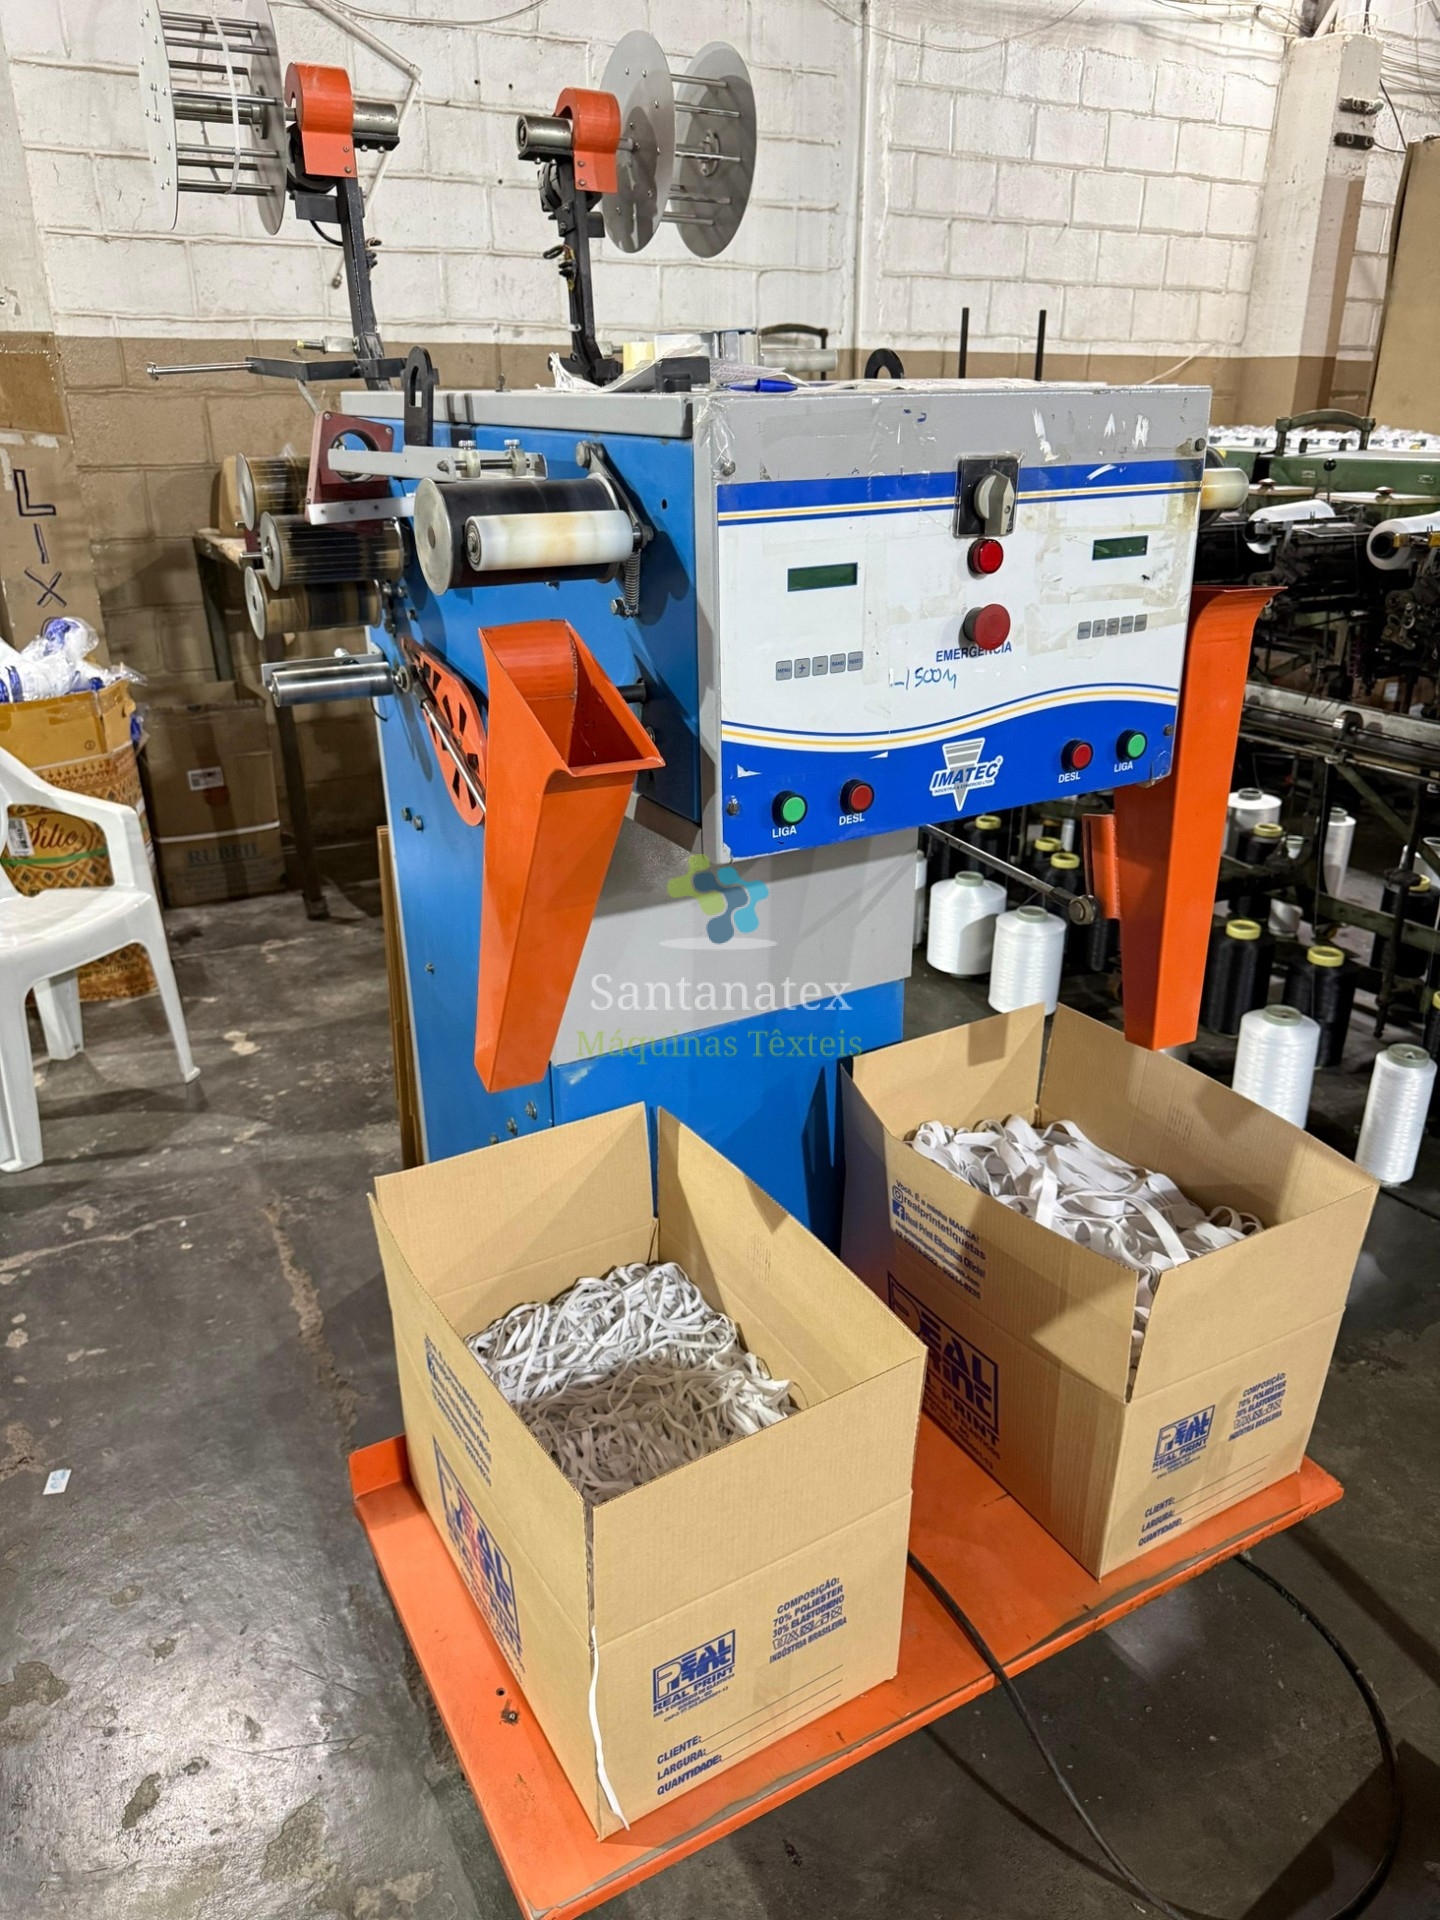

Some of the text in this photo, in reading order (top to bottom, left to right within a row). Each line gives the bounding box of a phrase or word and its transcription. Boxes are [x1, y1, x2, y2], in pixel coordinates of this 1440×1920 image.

[1058, 771, 1081, 783] DESL
[1113, 761, 1134, 773] LIGA
[772, 825, 797, 838] LIGA
[838, 813, 865, 826] DESL
[1144, 1496, 1175, 1518] CLIENTE:
[773, 1585, 843, 1627] 70% POLIESTER
[777, 1577, 840, 1614] COMPOSIÇÃO:
[772, 1623, 789, 1639] 30%
[653, 1690, 690, 1712] REAL
[693, 1664, 735, 1692] PRINT
[657, 1735, 701, 1765] CLIENTE:
[657, 1748, 706, 1781] LARGURA:
[657, 1754, 722, 1796] QUANTIDADE:
